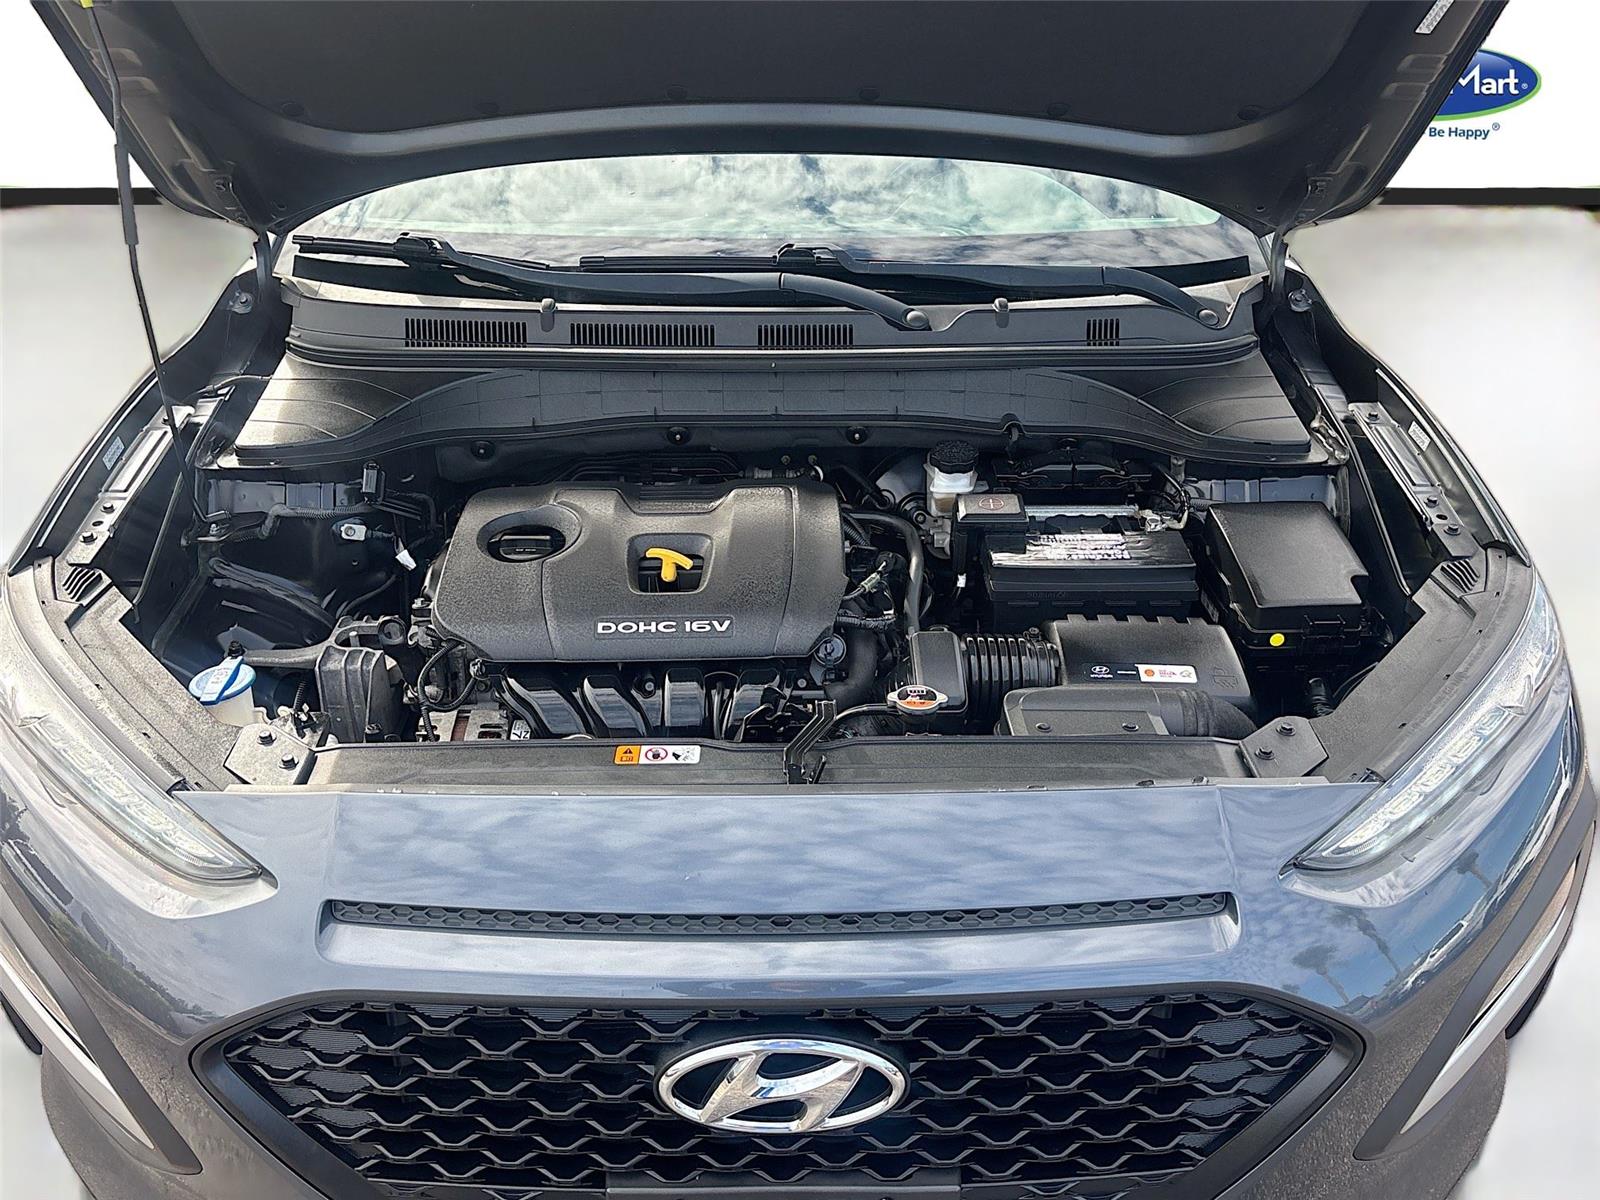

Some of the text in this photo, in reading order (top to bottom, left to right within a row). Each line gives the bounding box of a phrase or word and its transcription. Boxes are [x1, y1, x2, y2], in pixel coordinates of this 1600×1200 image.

[1429, 127, 1490, 140] Be Happy
[597, 620, 731, 634] DOHC 16V
